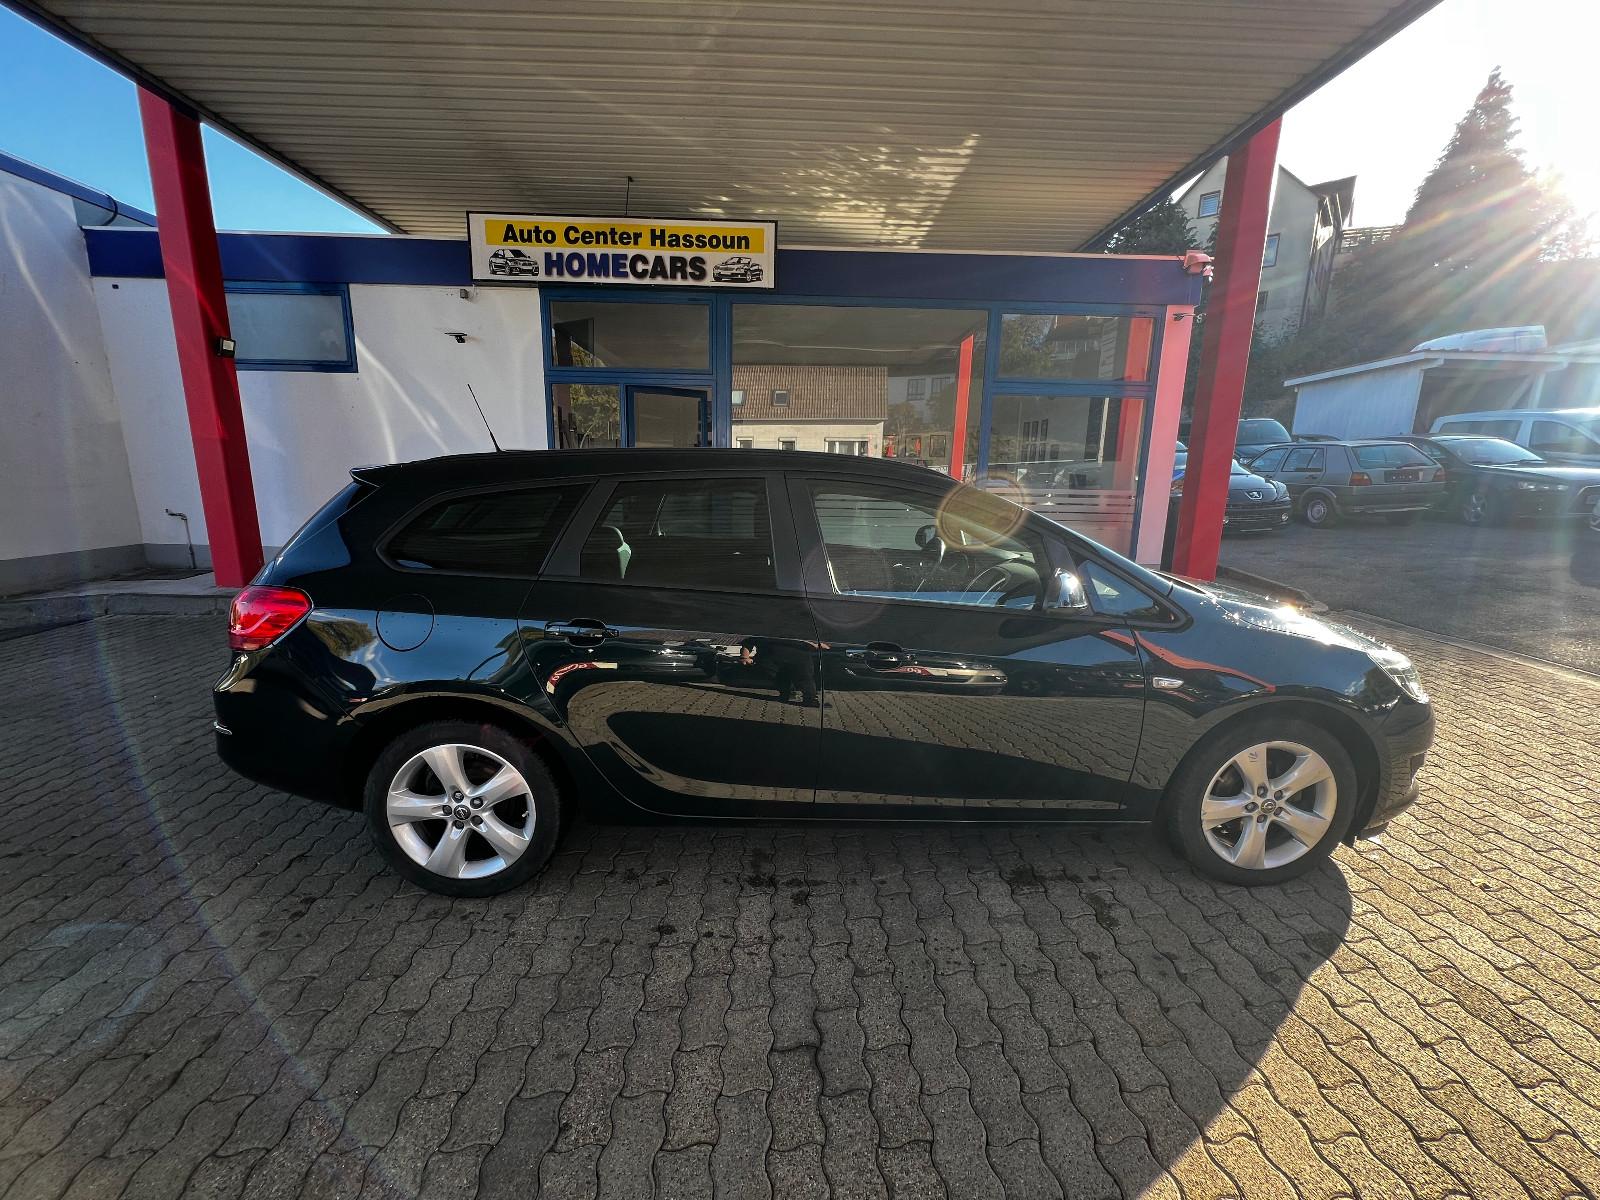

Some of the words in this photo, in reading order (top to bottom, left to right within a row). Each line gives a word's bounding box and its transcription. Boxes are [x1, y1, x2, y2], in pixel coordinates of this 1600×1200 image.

[503, 224, 556, 244] Auto
[563, 225, 643, 246] Center
[650, 228, 749, 250] Hassoun
[544, 252, 706, 281] HOMECARS
